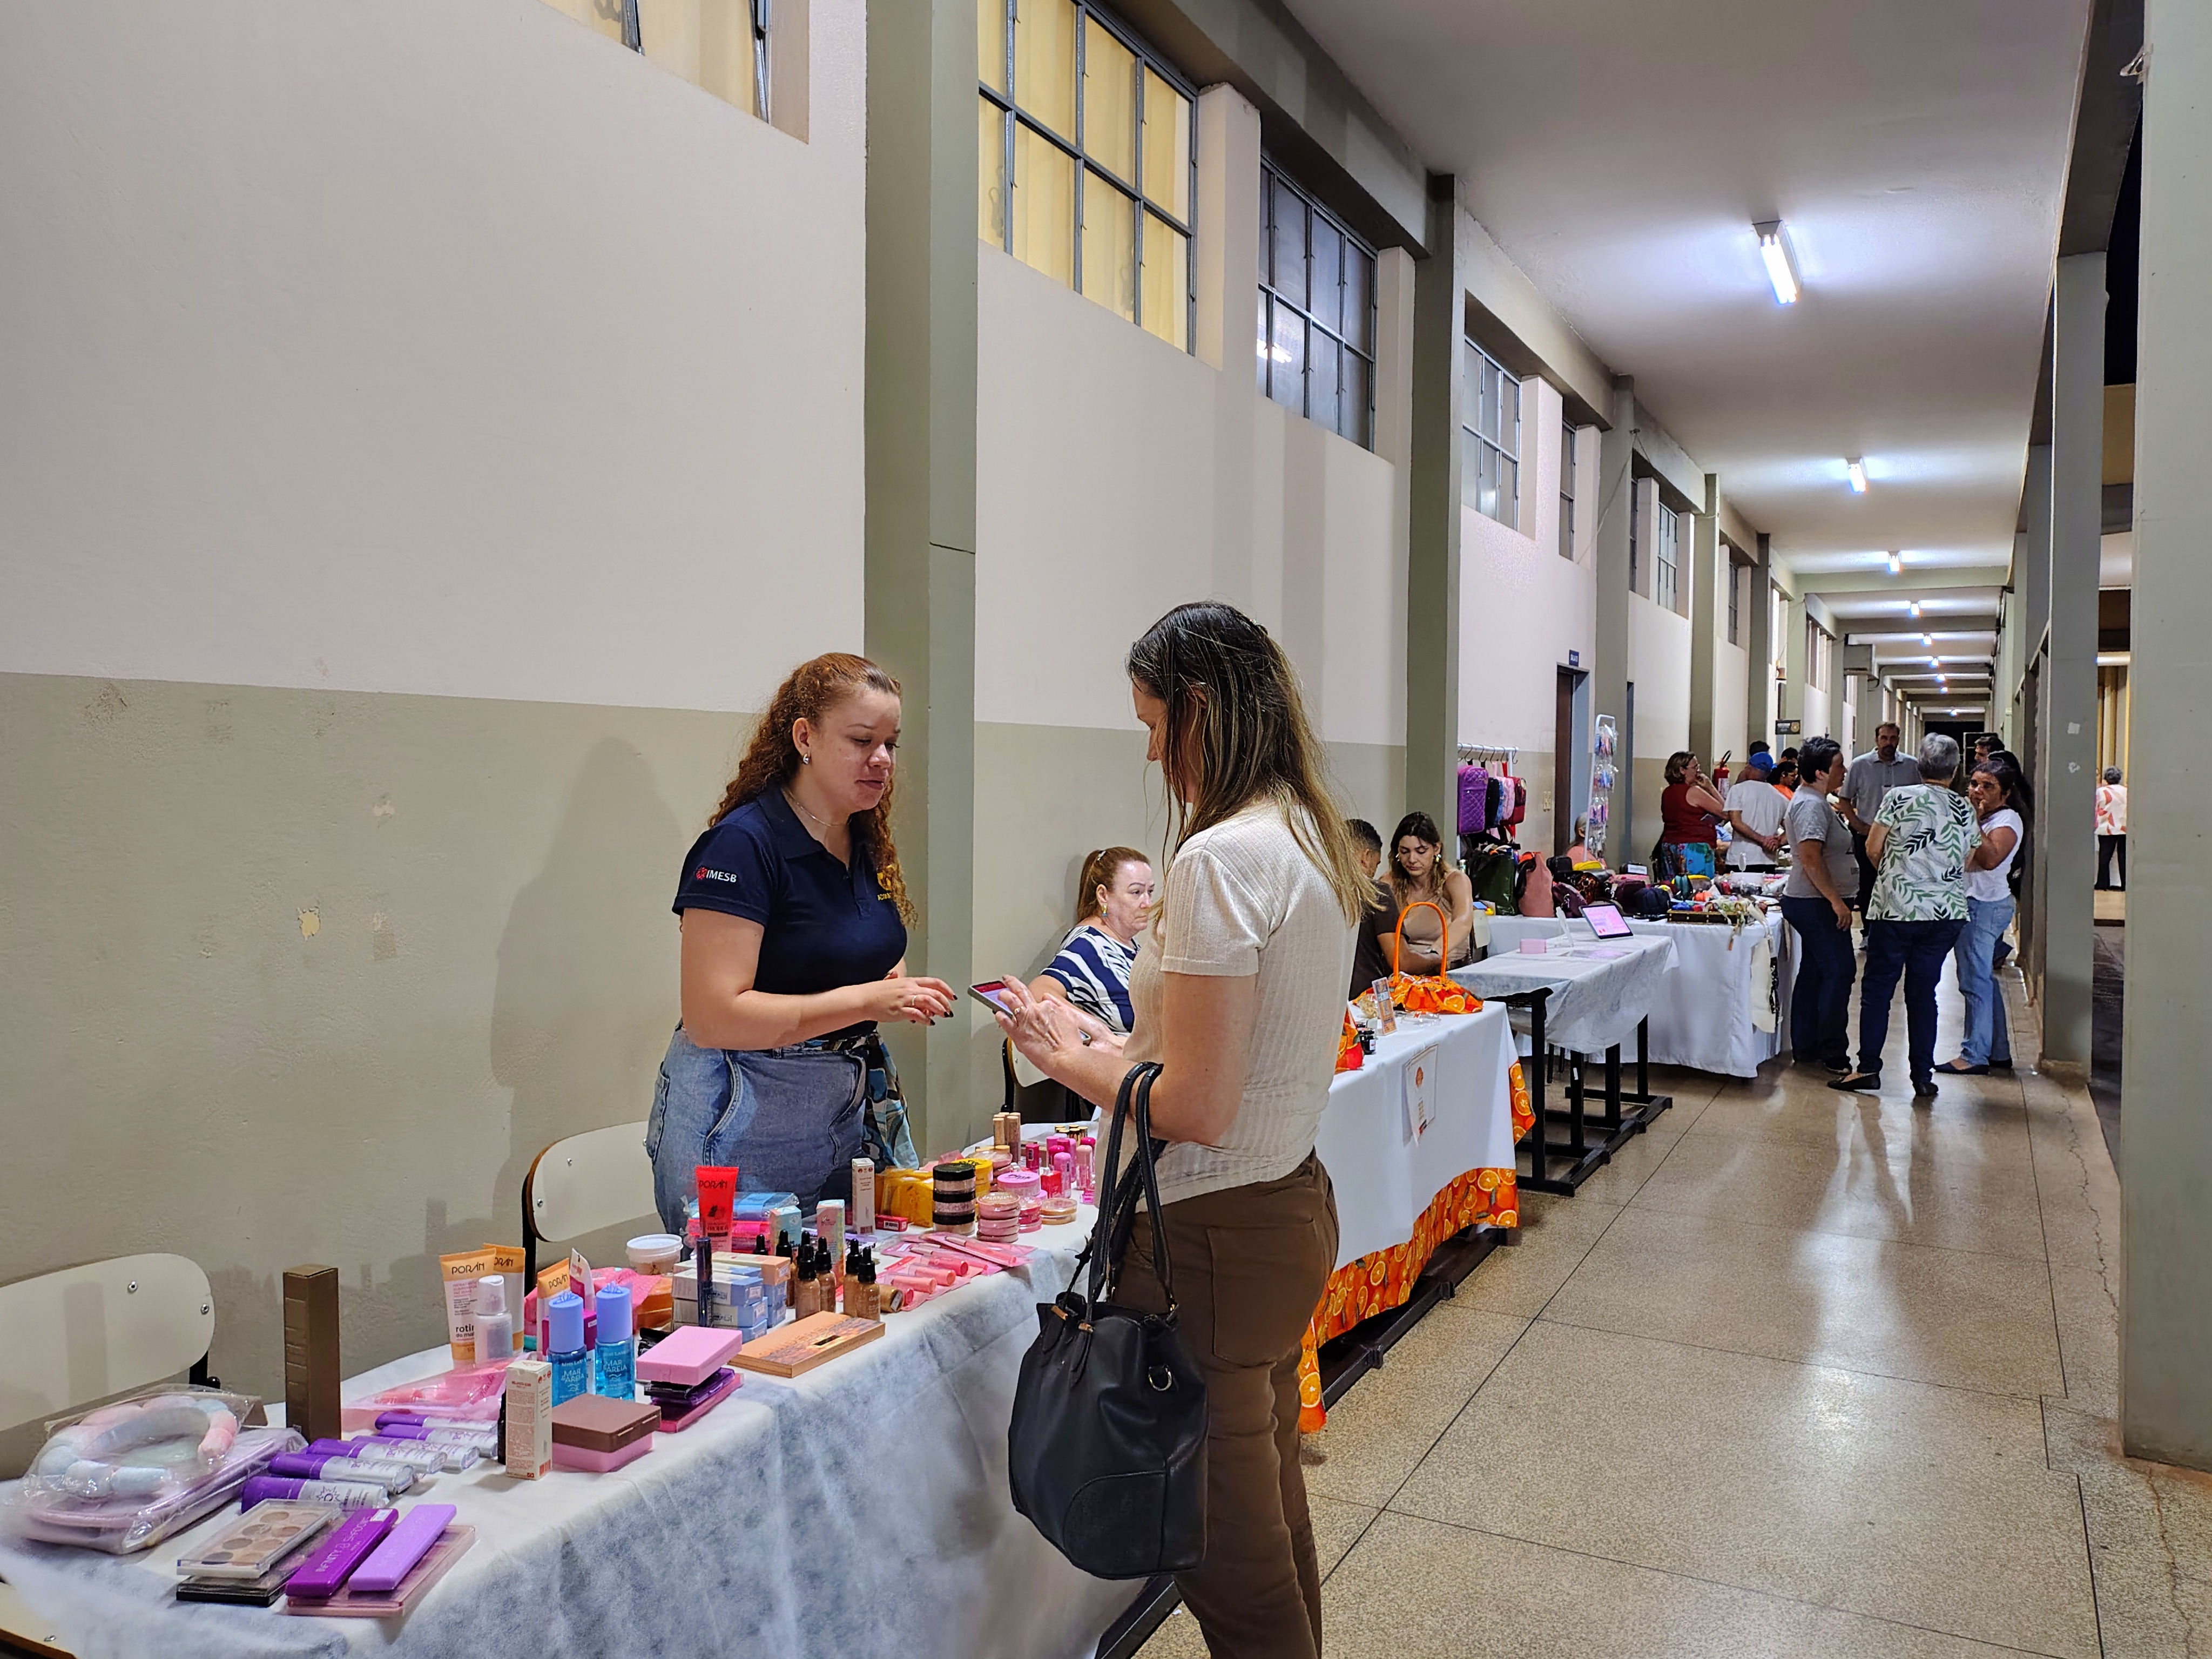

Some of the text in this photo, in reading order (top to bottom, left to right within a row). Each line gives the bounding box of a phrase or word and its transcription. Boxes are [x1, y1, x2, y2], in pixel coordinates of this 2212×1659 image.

[706, 869, 737, 883] IMESB
[494, 1257, 514, 1267] ORÁN
[451, 1262, 485, 1274] PORÁN
[564, 1368, 581, 1377] MAR
